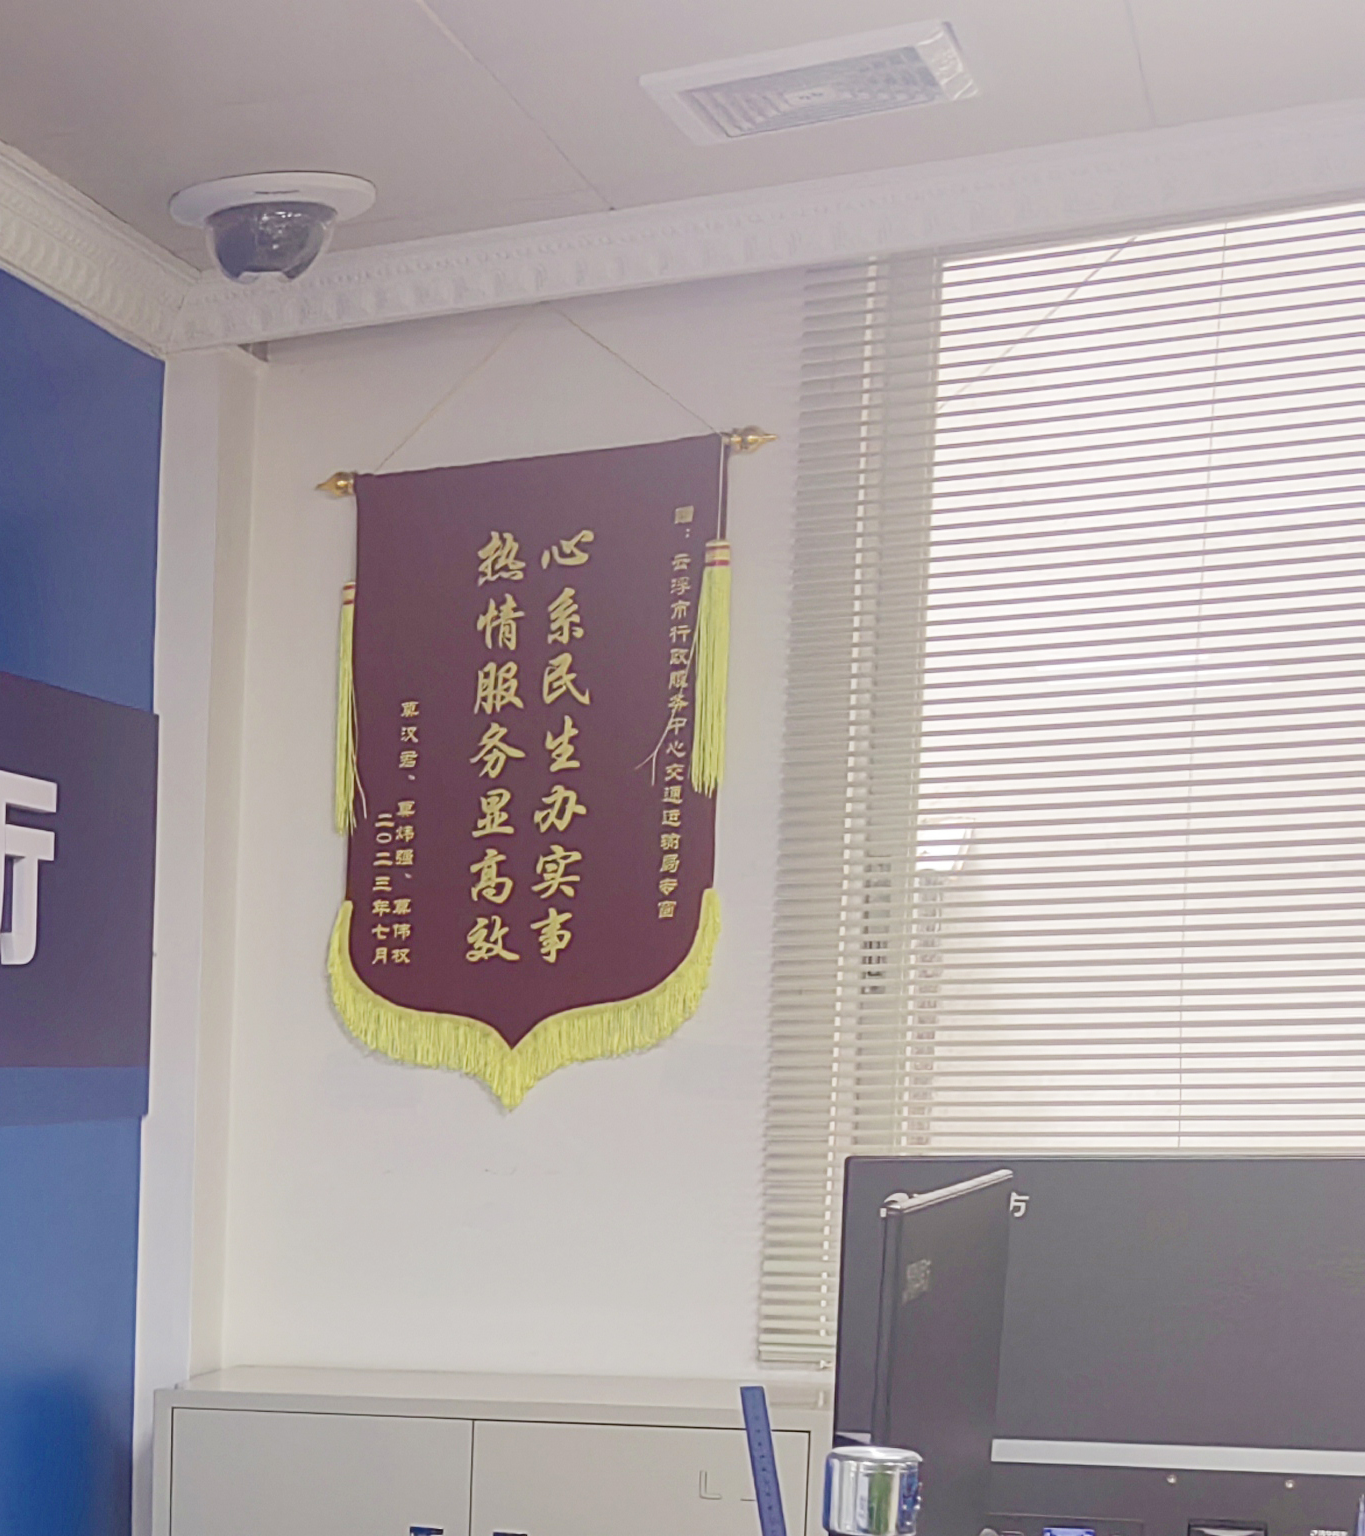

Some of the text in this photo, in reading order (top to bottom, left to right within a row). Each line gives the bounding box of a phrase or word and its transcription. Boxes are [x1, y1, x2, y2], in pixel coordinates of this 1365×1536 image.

[466, 531, 526, 963] 热情服务显高效
[529, 529, 594, 963] 心系民生办实事
